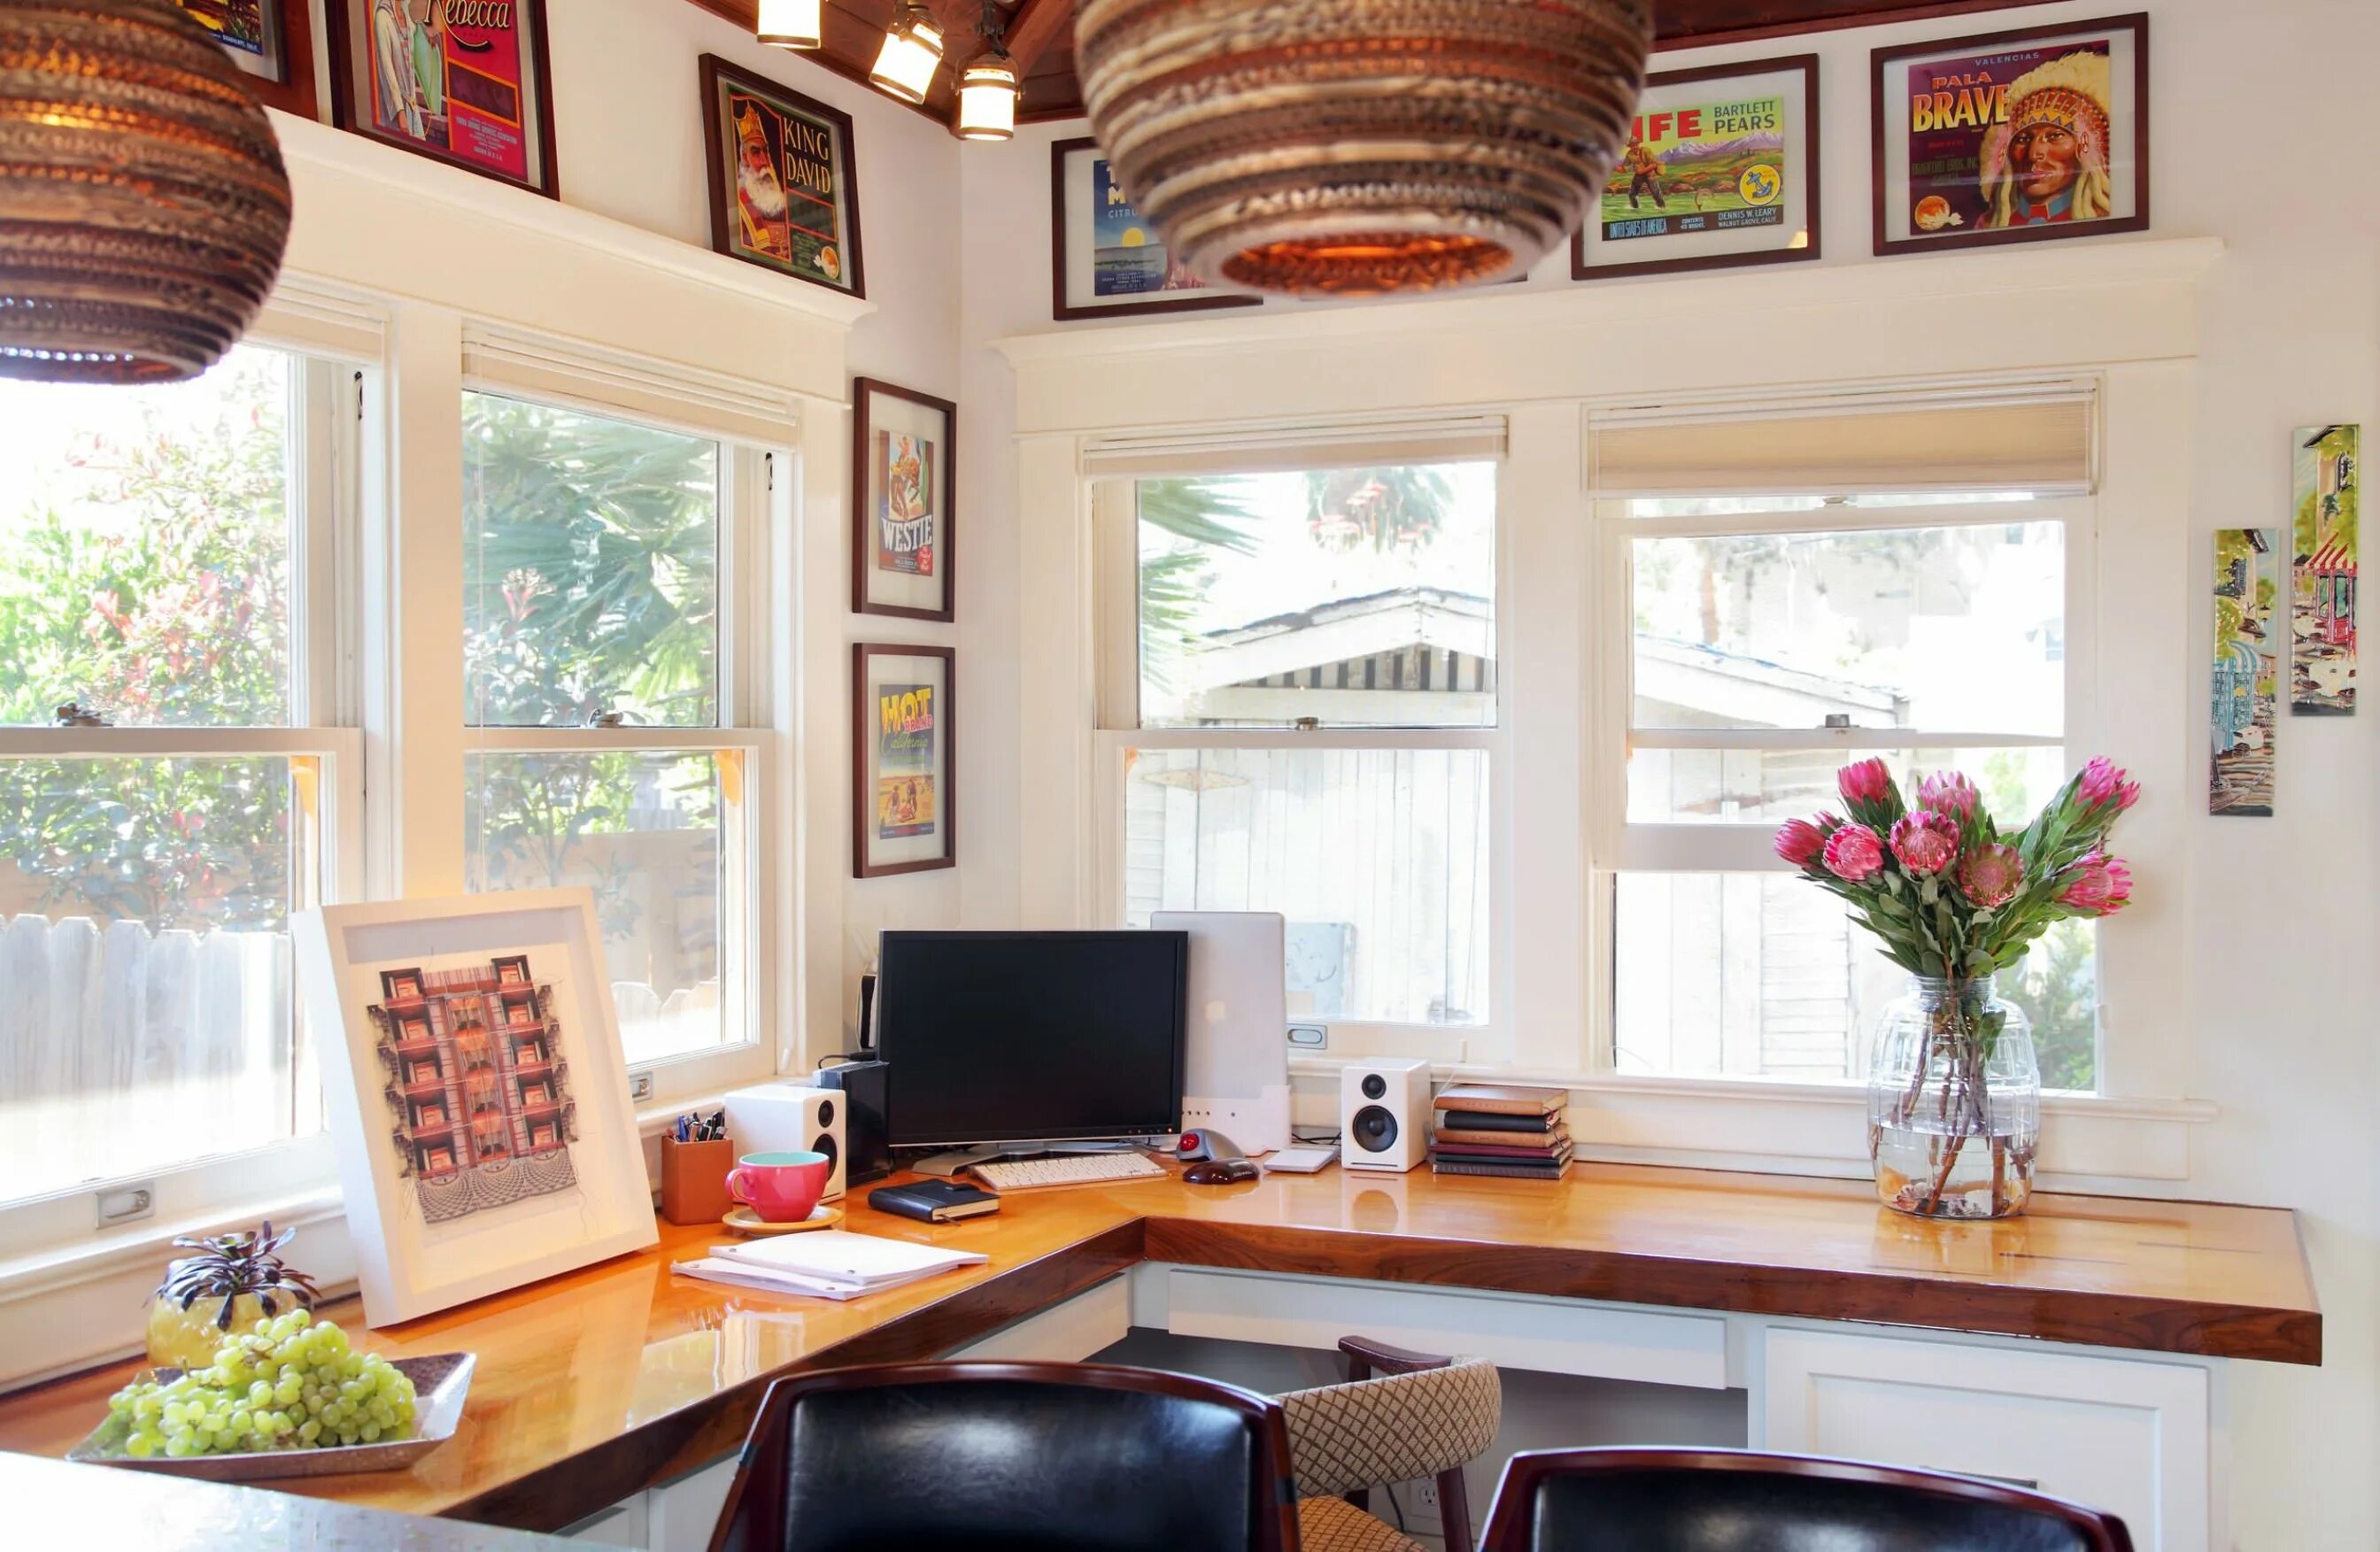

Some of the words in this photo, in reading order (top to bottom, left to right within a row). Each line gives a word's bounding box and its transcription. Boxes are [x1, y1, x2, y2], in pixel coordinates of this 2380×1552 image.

[423, 0, 510, 47] Rebecca
[1974, 52, 2040, 66] VALENCIAS
[1932, 71, 1993, 90] PALA
[1631, 109, 1702, 143] IFE
[1713, 100, 1775, 118] BARTLETT
[1713, 114, 1775, 134] PEARS
[1912, 84, 2011, 132] BRAVE
[784, 117, 829, 160] KING
[785, 152, 831, 193] DAVID
[1718, 210, 1746, 220] DENNIS
[1755, 207, 1777, 217] LEARY
[882, 513, 932, 552] WESTIE
[881, 688, 931, 735] HOT
